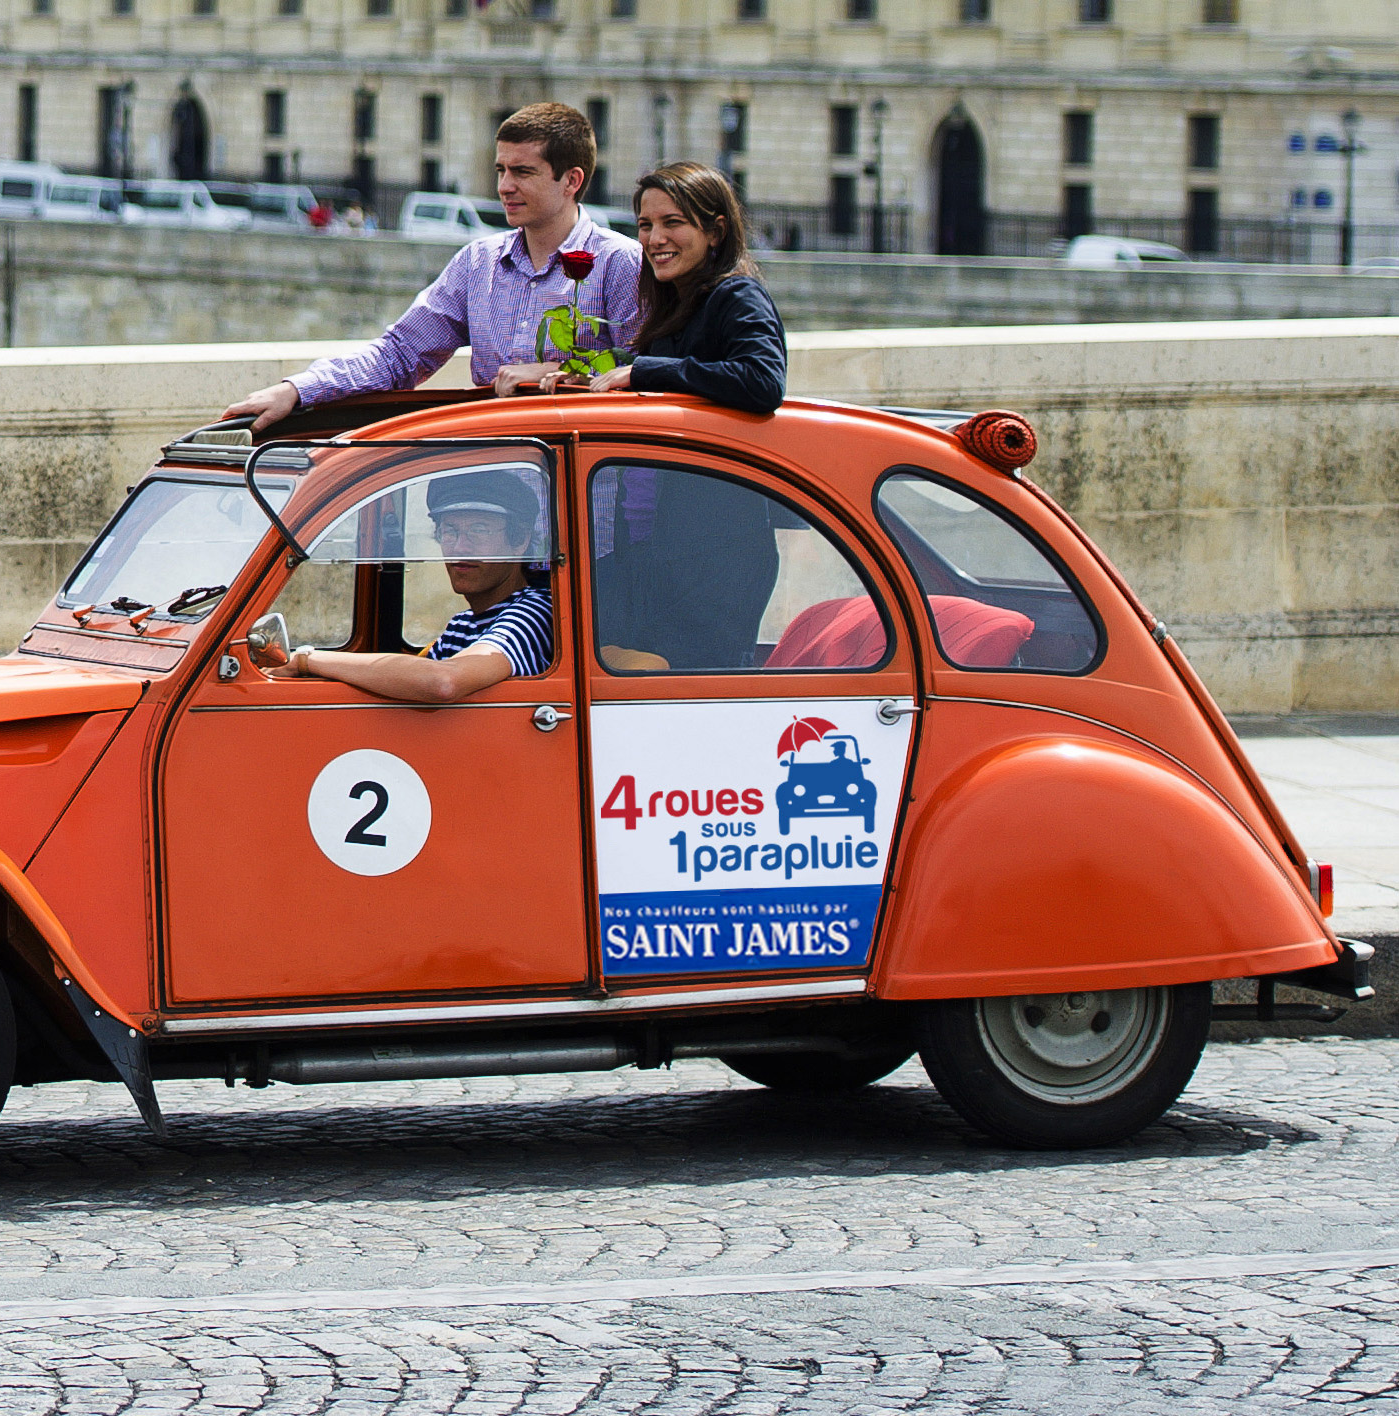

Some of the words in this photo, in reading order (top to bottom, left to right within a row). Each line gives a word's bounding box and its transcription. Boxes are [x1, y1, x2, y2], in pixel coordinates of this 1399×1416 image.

[344, 780, 389, 847] 2
[701, 821, 757, 838] sous
[604, 907, 632, 918] Nos
[636, 905, 717, 917] chauffeurs
[721, 905, 753, 916] sont
[824, 903, 849, 916] par
[606, 923, 721, 960] SAINT
